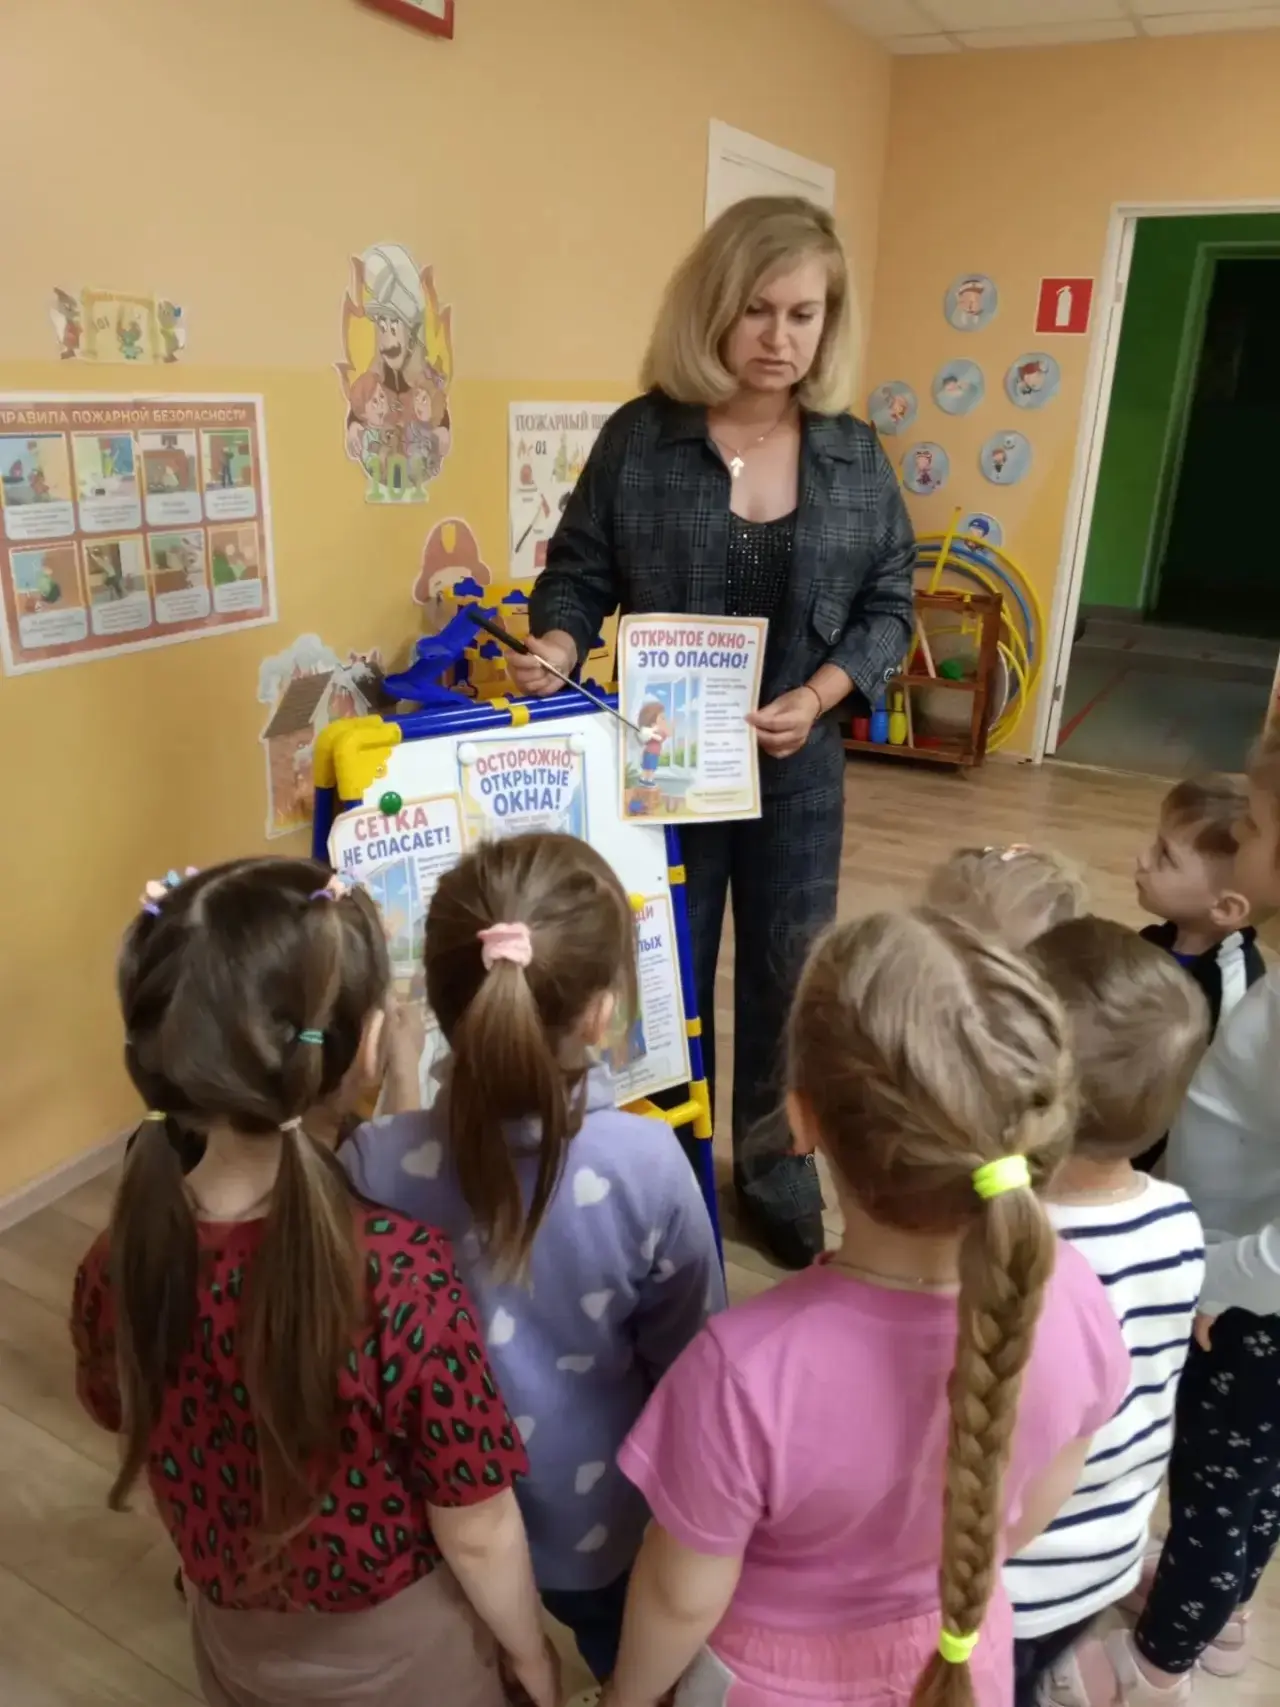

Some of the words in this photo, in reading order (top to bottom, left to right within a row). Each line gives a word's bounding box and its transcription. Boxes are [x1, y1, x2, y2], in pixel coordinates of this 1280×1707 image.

[72, 406, 149, 424] ПОЖАРНОЙ
[153, 408, 247, 422] БЕЗОПАСНОСТИ
[515, 410, 588, 431] ПОЖАРНЫЙ
[535, 440, 547, 455] 01
[630, 630, 704, 647] ОТКРЫТОЕ
[638, 650, 669, 668] ЭТО
[675, 651, 749, 669] ОПАСНО!
[476, 748, 573, 775] ОСТОРОЖНО,
[480, 768, 570, 795] ОТКРЫТЫЕ
[493, 787, 561, 817] ОКНА!
[354, 806, 428, 841] СЕТКА
[343, 846, 363, 868] НЕ
[366, 826, 450, 861] СПАСАЕТ!
